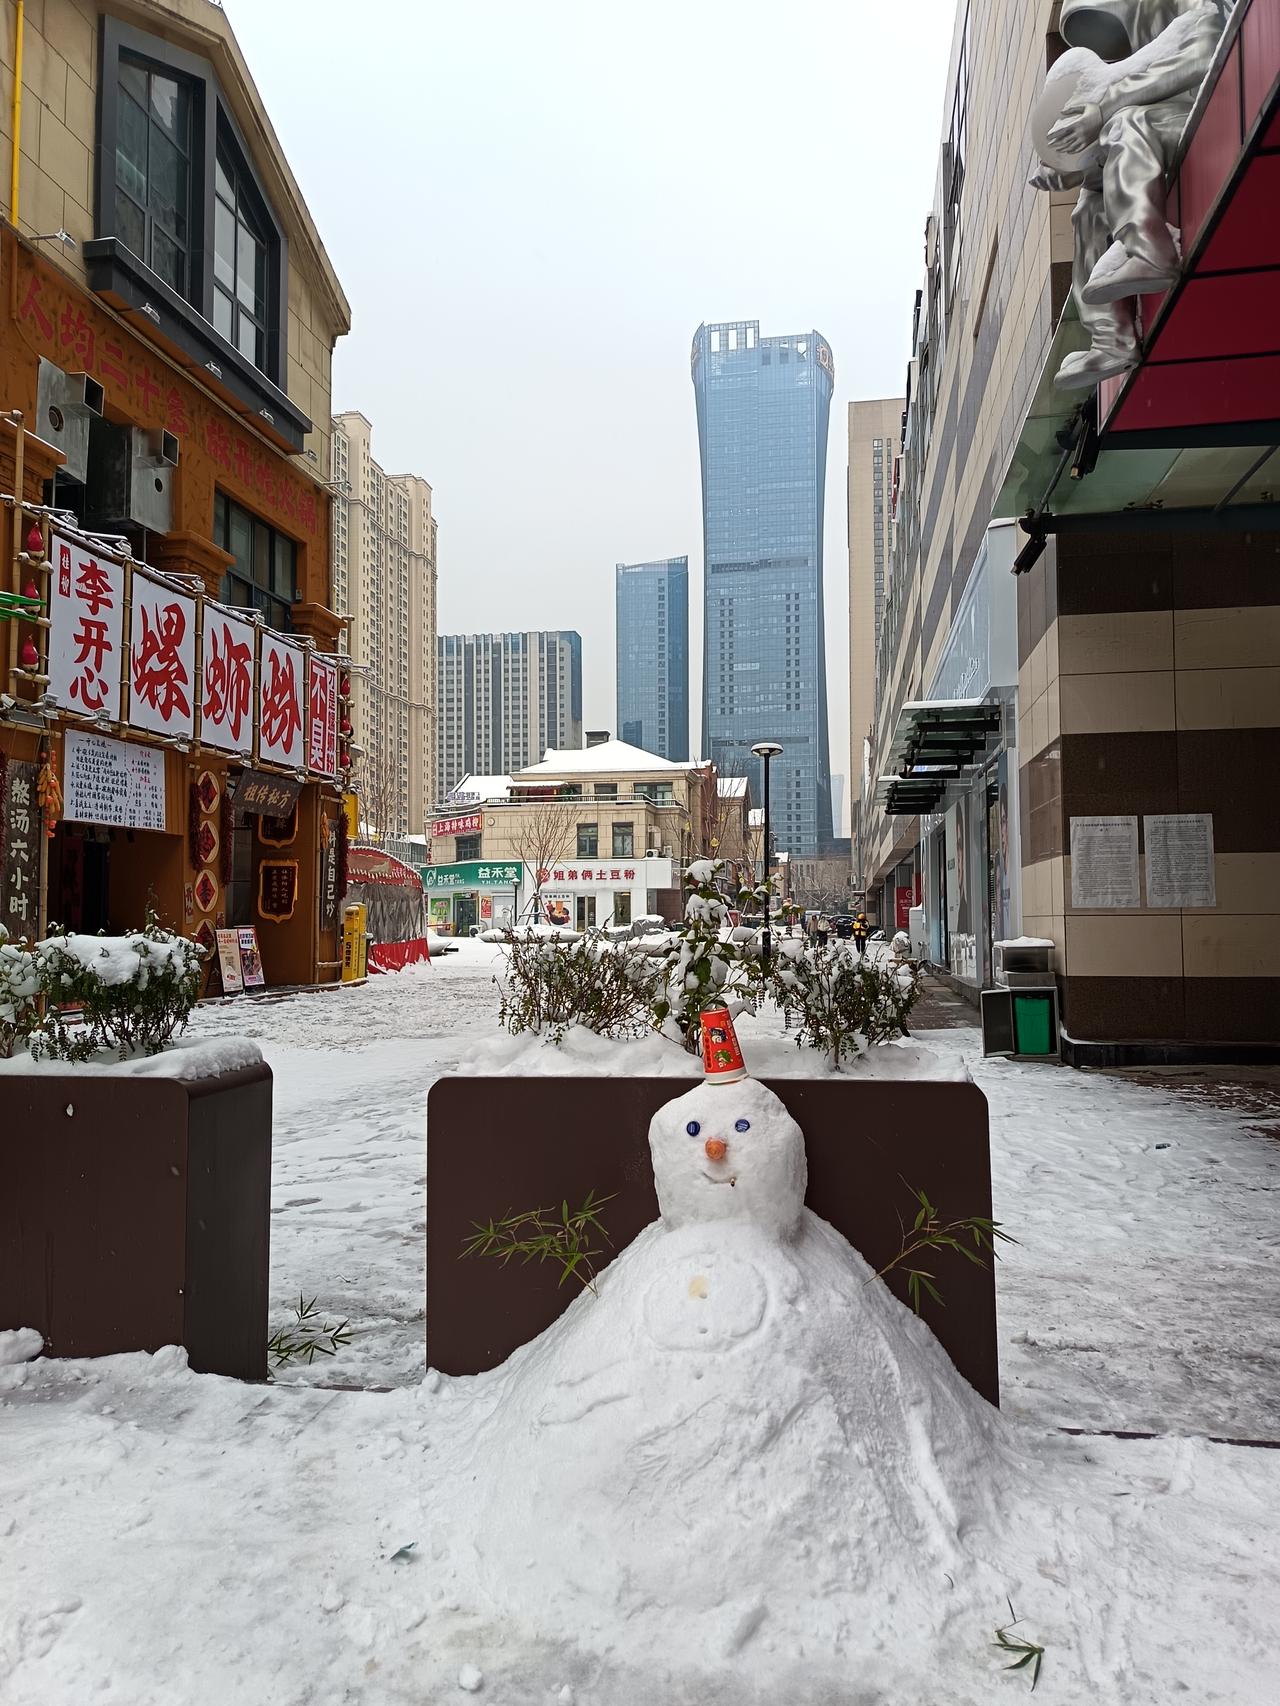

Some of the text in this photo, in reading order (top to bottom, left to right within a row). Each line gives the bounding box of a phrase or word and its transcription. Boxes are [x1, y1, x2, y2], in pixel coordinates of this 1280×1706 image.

[69, 558, 114, 712] 李开心
[133, 602, 302, 755] 螺蛳粉
[311, 664, 326, 769] 不臭
[244, 782, 291, 809] 祖传秘方
[9, 777, 30, 921] 熬汤六小时
[478, 866, 517, 879] 益禾堂
[553, 869, 635, 881] 姐弟俩土豆粉
